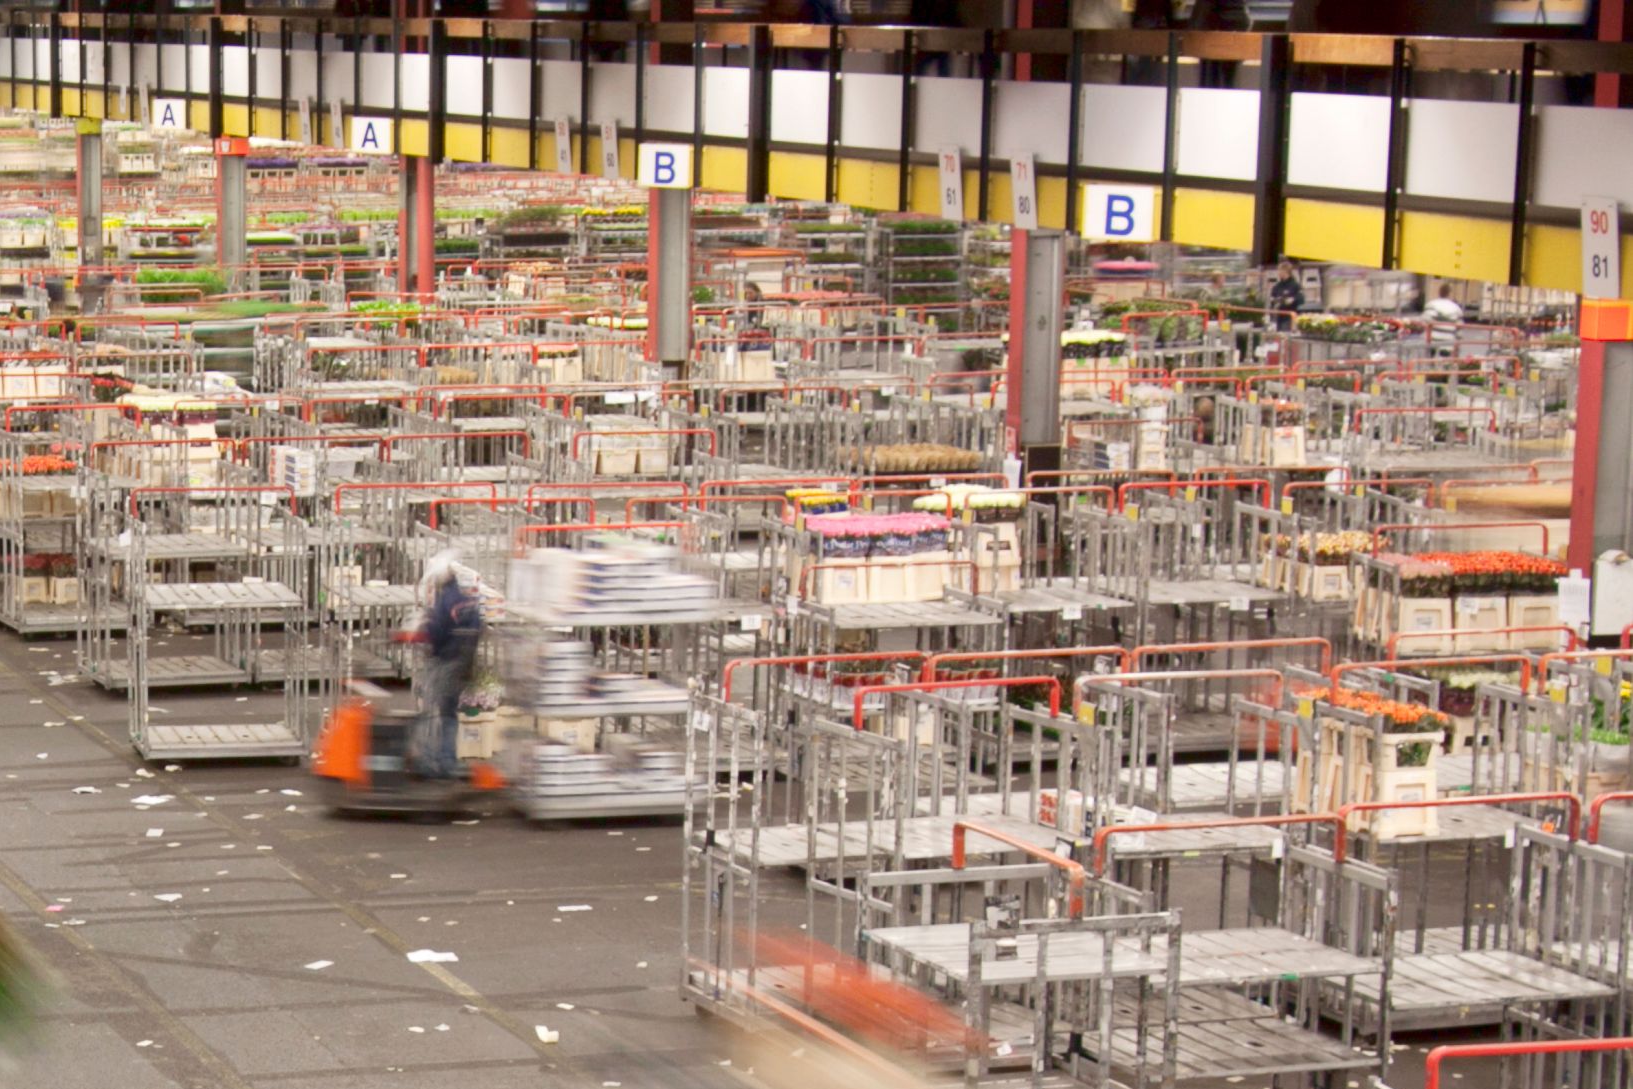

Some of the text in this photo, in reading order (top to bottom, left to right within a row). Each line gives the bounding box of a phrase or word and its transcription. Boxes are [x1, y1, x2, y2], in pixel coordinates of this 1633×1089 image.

[162, 103, 176, 126] A
[361, 122, 379, 148] A
[654, 152, 676, 184] B
[946, 187, 956, 205] 61
[1018, 195, 1030, 214] 80
[1105, 194, 1135, 235] B
[1591, 210, 1608, 234] 90
[1592, 254, 1608, 278] 81
